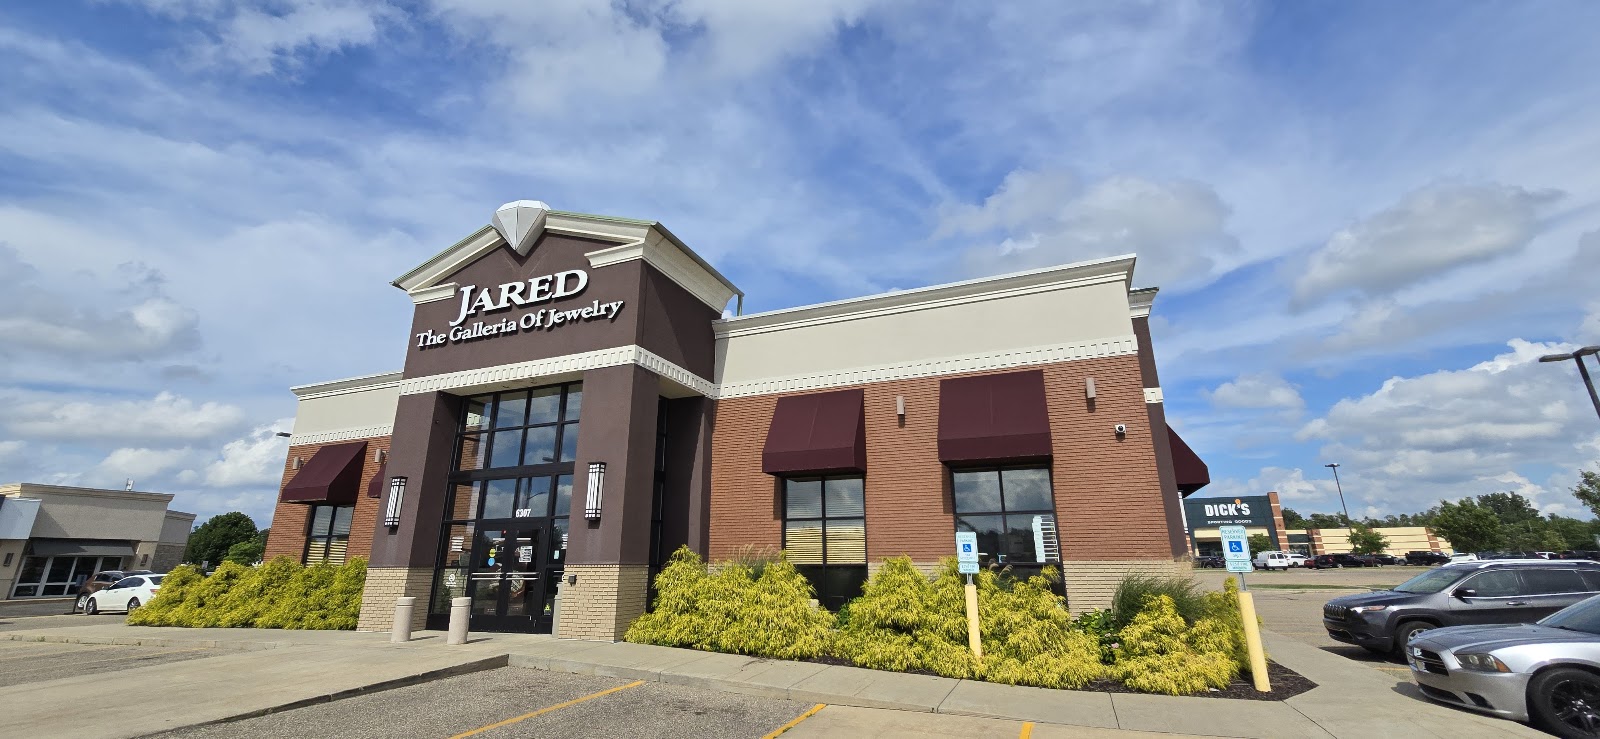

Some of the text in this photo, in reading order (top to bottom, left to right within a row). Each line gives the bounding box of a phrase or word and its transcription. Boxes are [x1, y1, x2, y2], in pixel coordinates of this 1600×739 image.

[449, 269, 588, 326] JARED
[416, 300, 624, 347] The Galleria Of Jewelry
[515, 509, 531, 518] 6307
[1204, 503, 1250, 516] DICK'S
